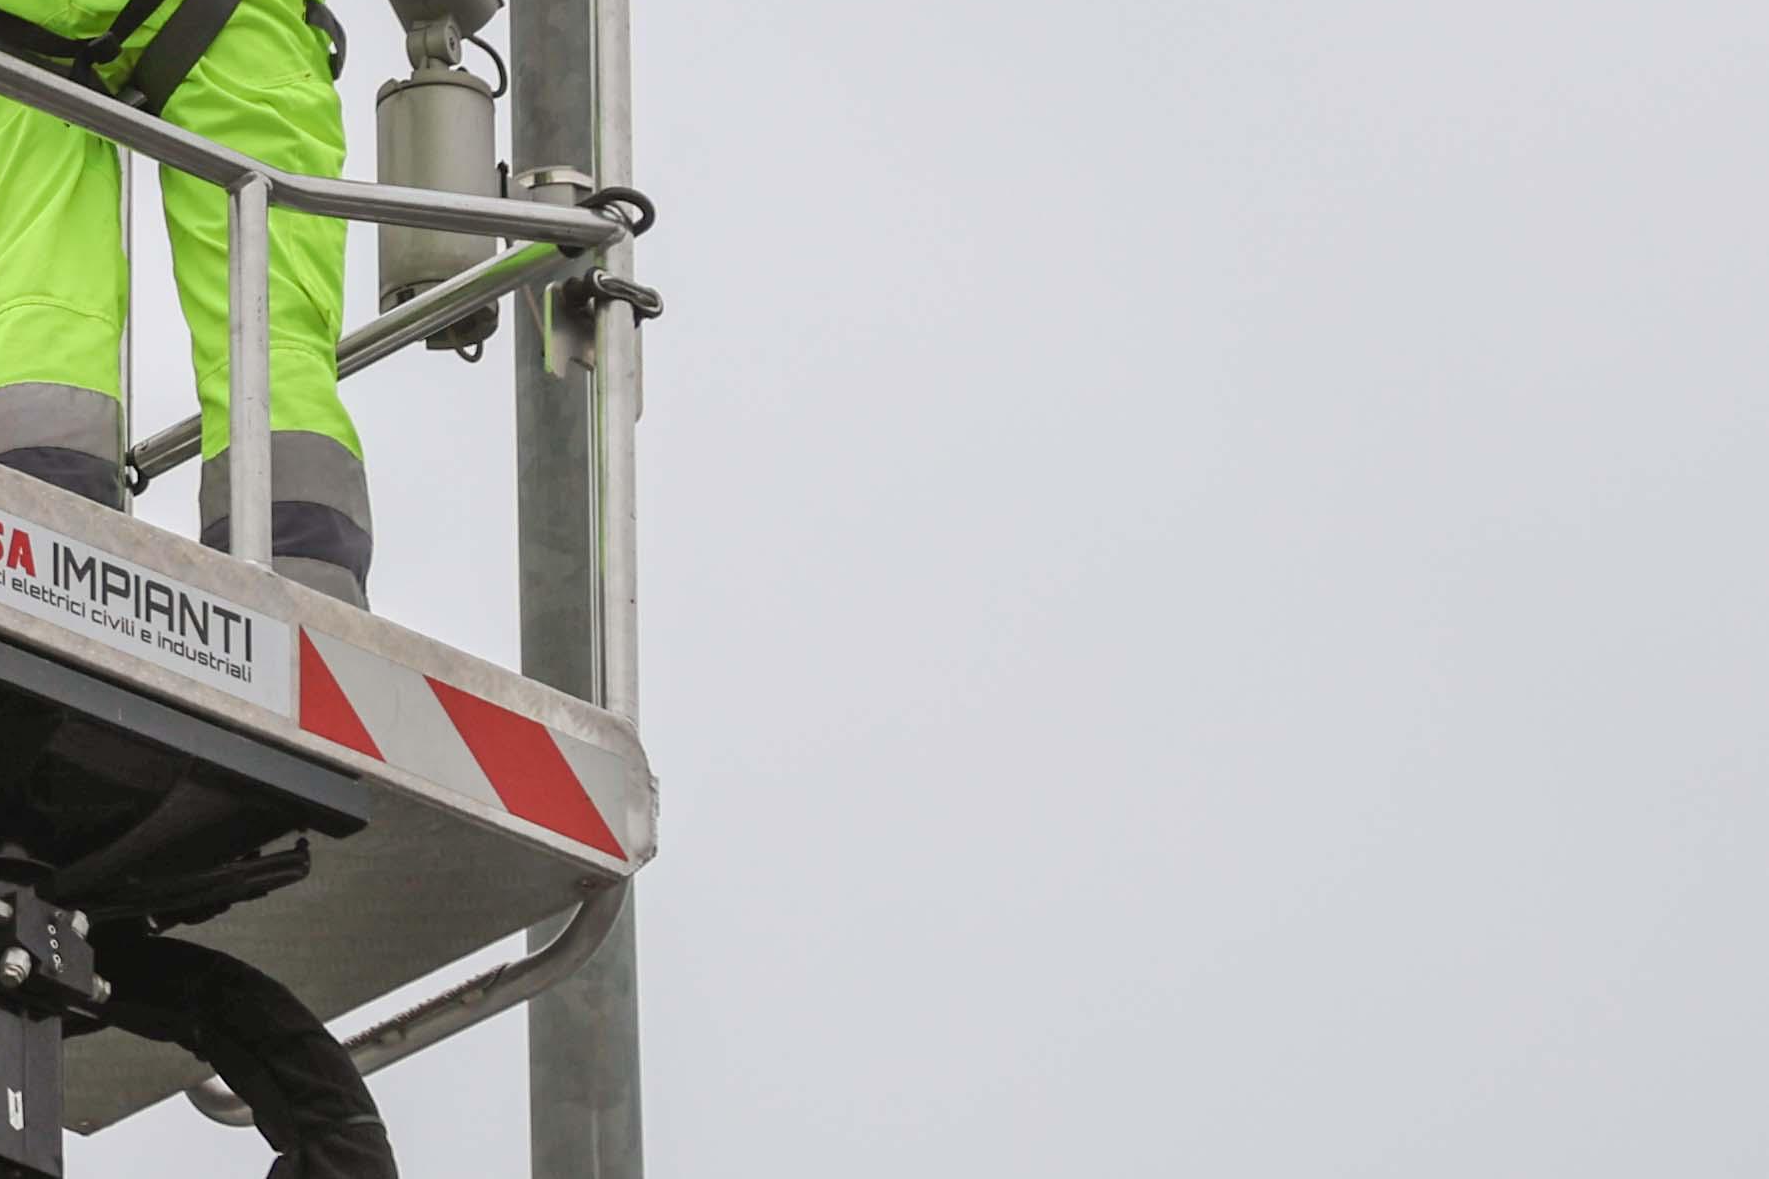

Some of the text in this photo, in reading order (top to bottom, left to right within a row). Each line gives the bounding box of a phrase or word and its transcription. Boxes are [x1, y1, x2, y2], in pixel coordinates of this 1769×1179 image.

[12, 577, 86, 617] elettrici
[91, 606, 135, 637] civili
[140, 628, 152, 644] e
[157, 634, 252, 683] industriali
[53, 542, 252, 661] IMPIANTI
